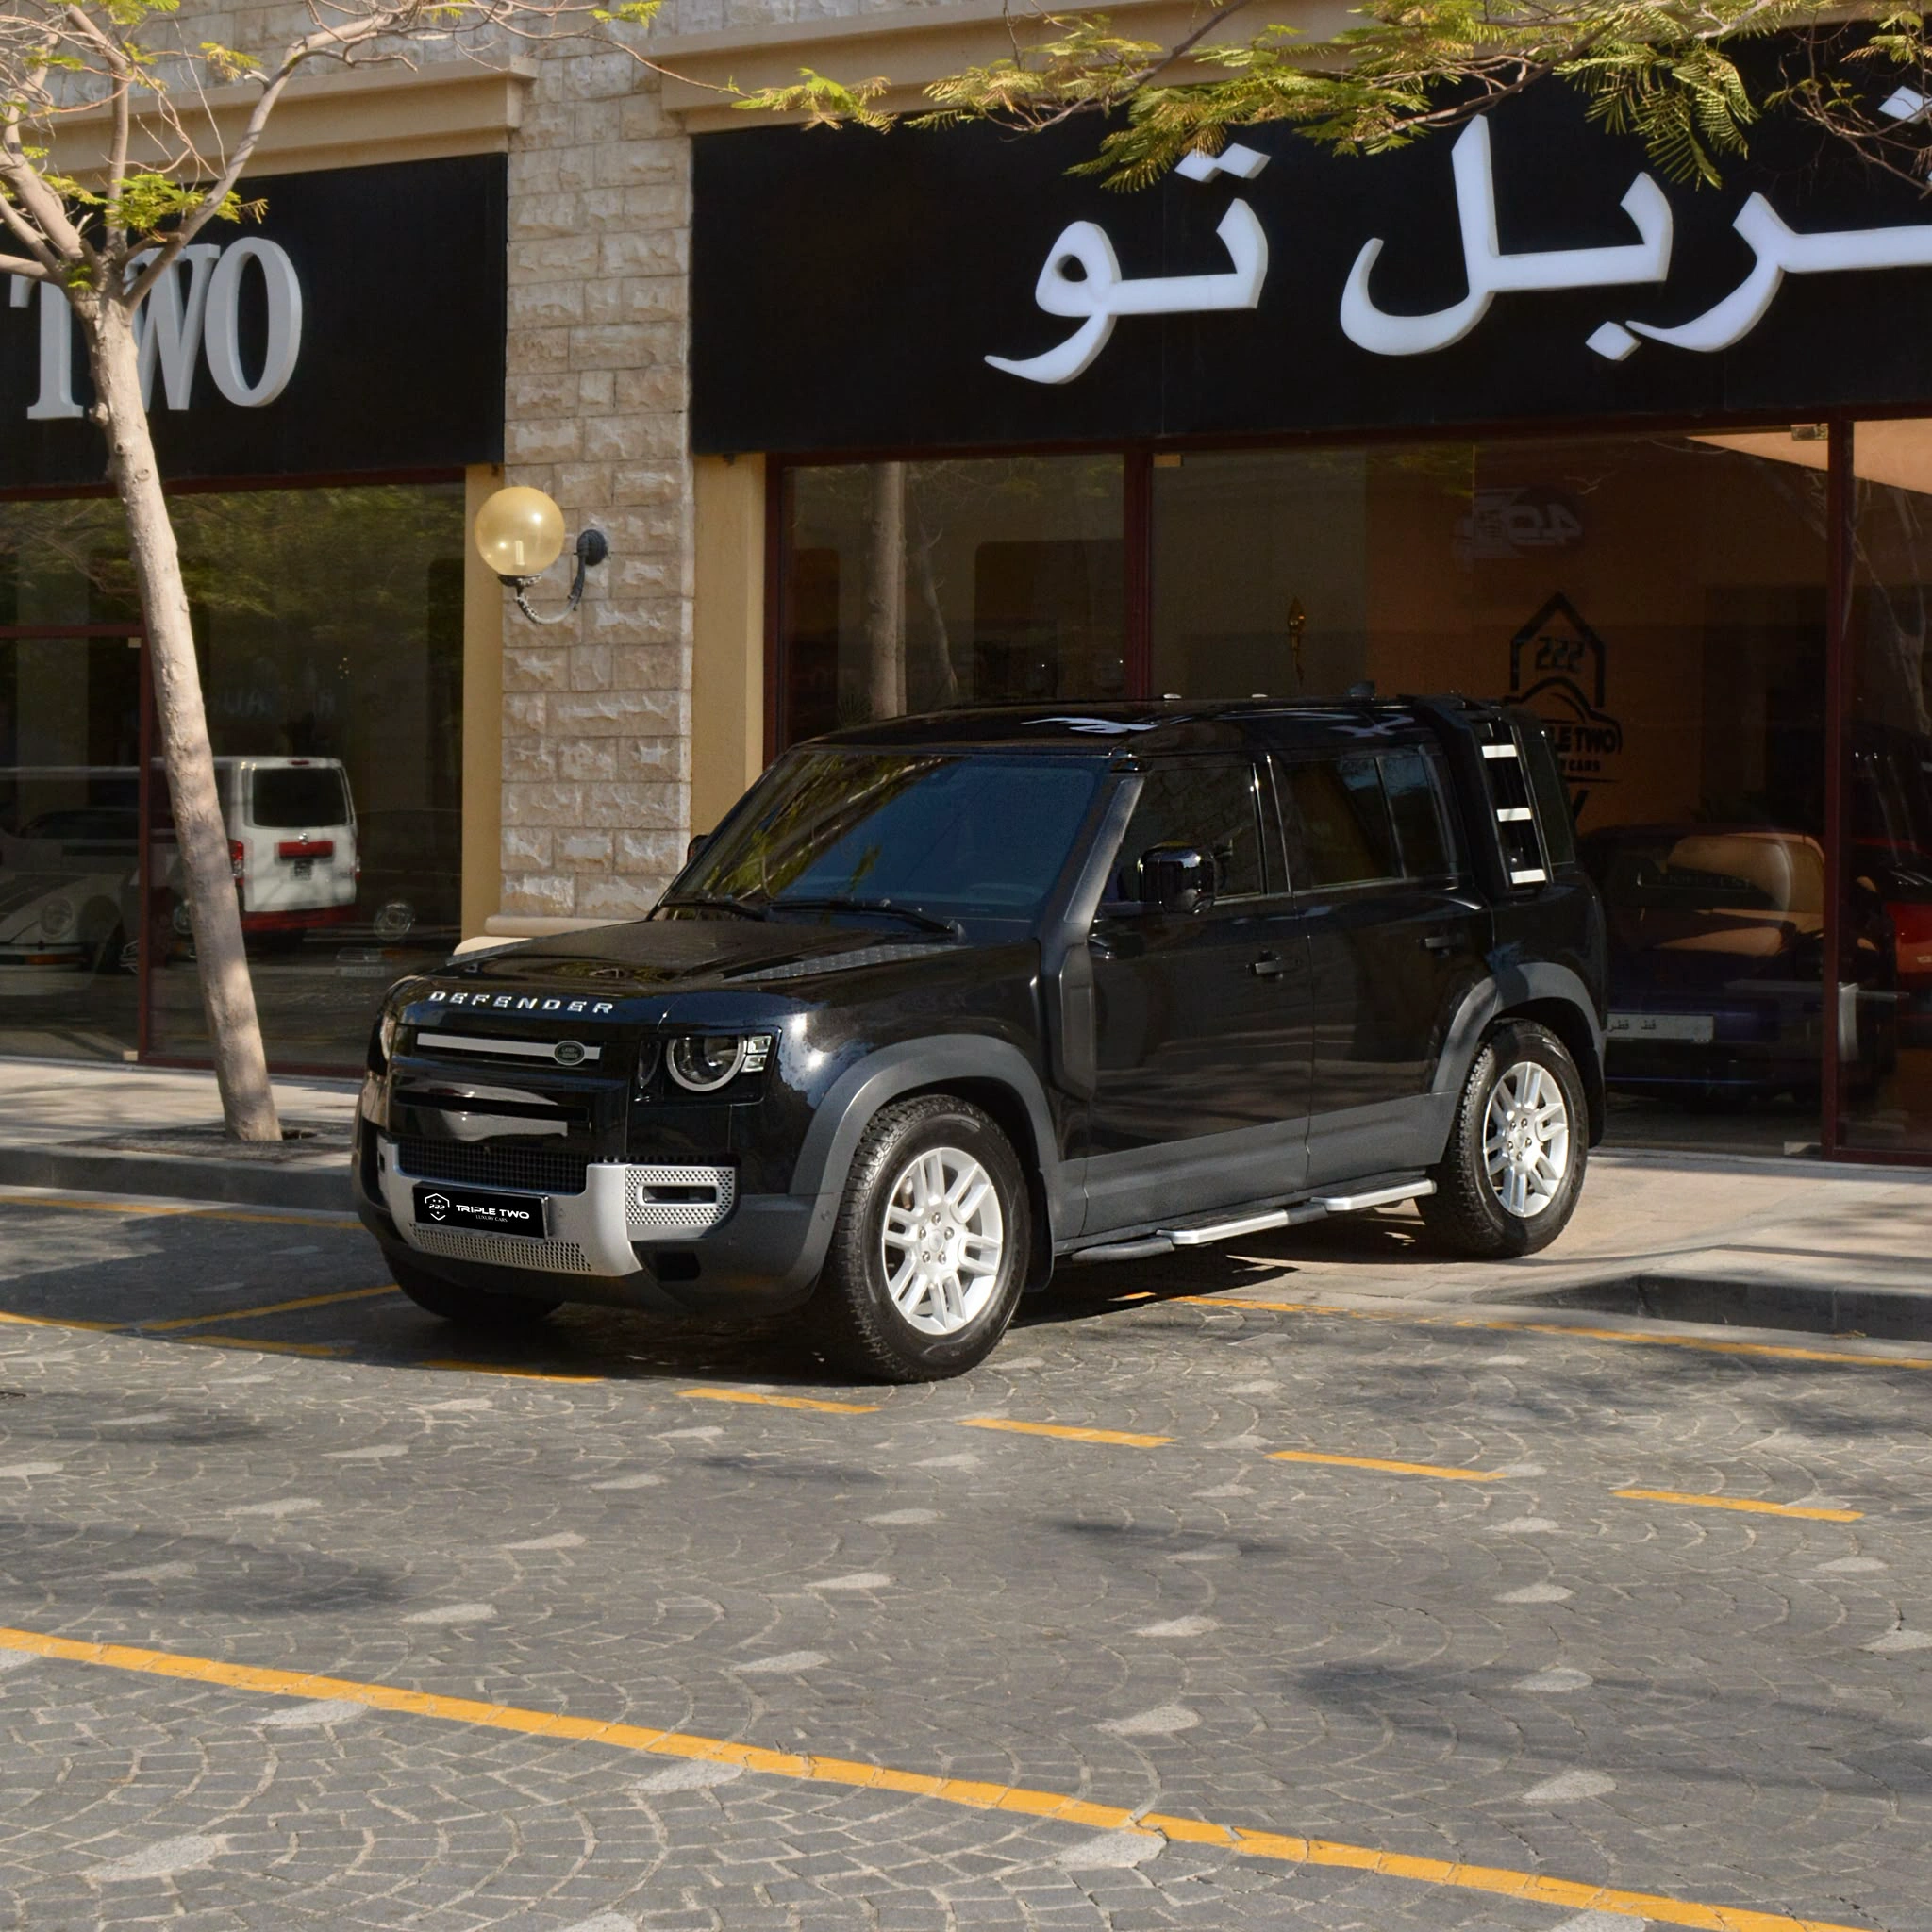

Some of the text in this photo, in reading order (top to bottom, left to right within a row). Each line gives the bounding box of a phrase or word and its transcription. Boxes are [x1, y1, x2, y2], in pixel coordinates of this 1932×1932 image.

[984, 142, 1272, 385] تو
[10, 236, 303, 420] TWO
[1574, 726, 1616, 754] TWO
[428, 991, 615, 1014] DEFENDER
[456, 1204, 531, 1220] TRIPLE TWO
